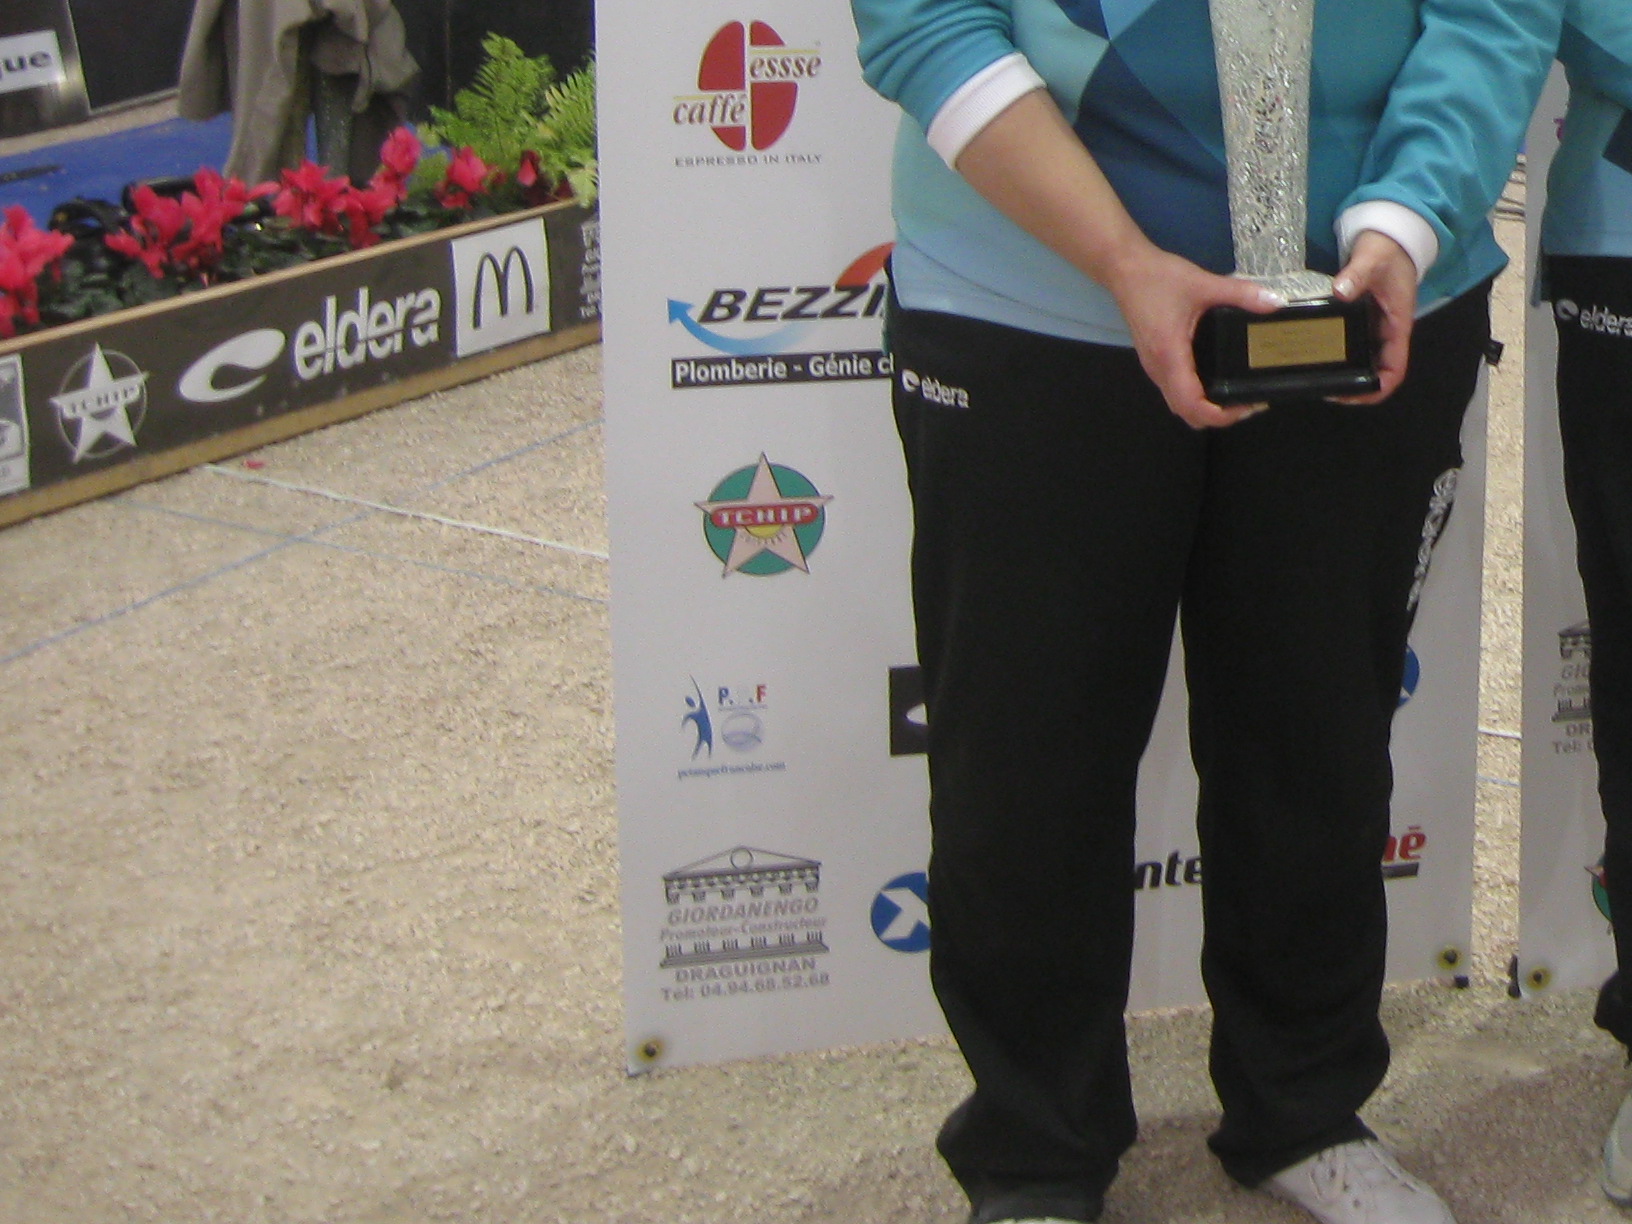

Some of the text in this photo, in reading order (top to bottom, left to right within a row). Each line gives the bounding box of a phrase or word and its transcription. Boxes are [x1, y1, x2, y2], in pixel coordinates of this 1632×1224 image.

[674, 155, 758, 168] ESPRESSO
[785, 153, 822, 164] ITALY
[697, 282, 887, 324] BEZZI
[294, 286, 443, 380] eldera
[675, 356, 788, 384] Plomberie
[809, 353, 873, 377] Génie
[667, 896, 820, 925] GIORDANENGO
[675, 957, 817, 983] DRAGUIGNAN
